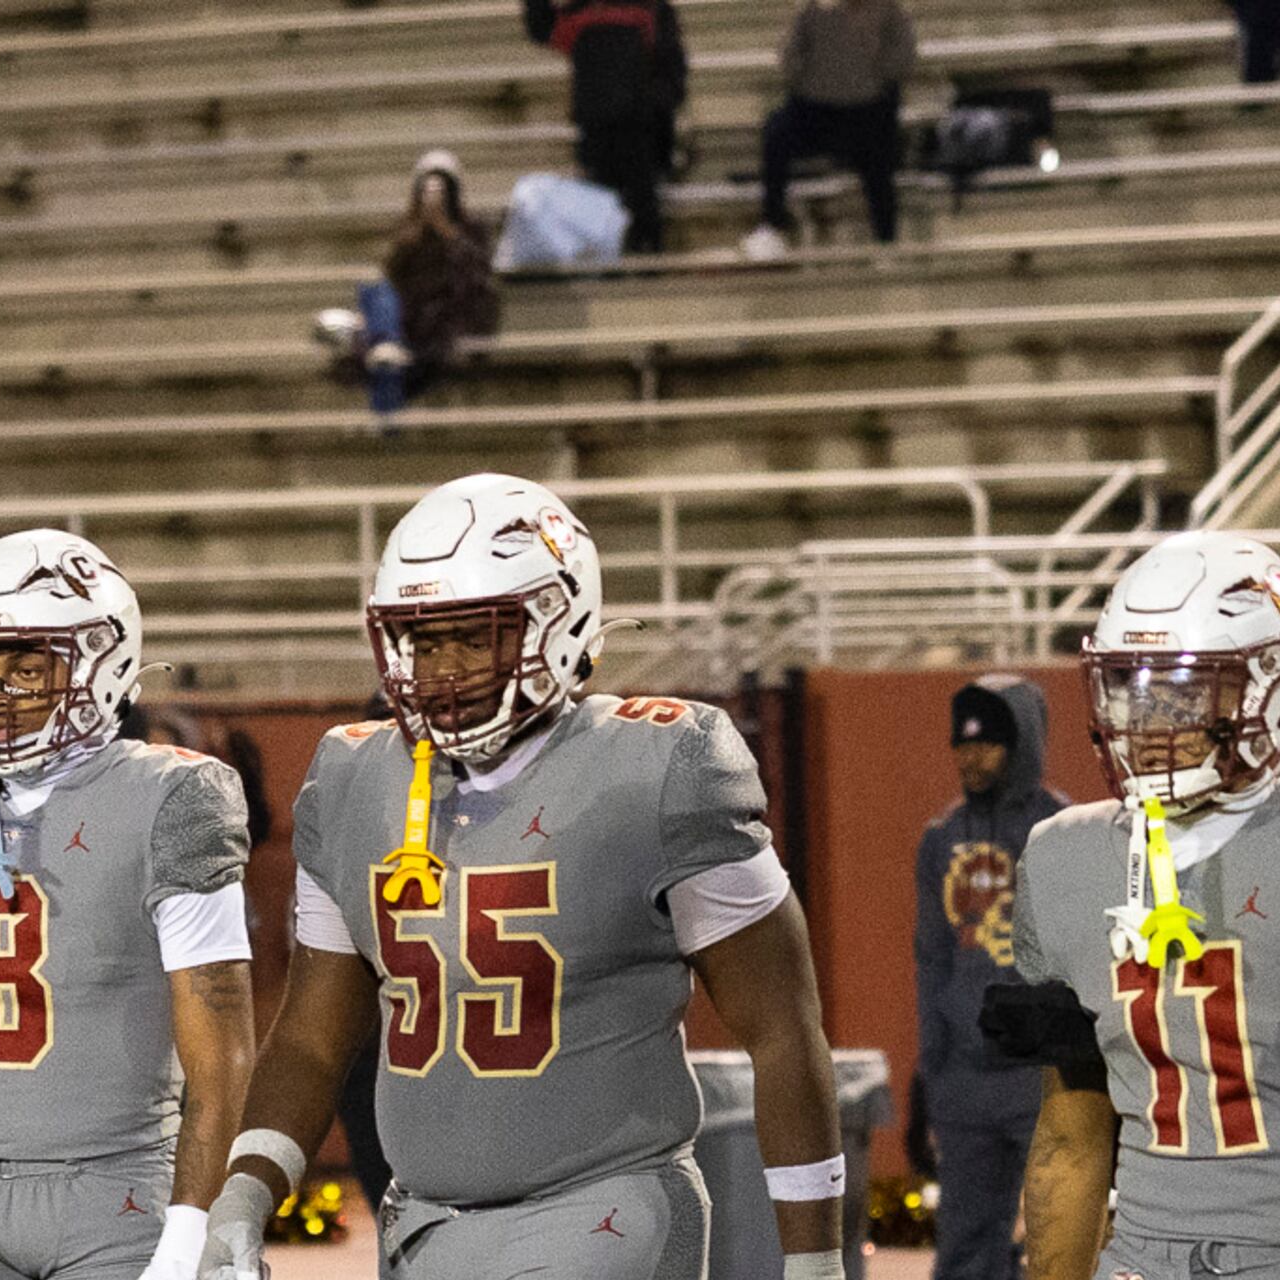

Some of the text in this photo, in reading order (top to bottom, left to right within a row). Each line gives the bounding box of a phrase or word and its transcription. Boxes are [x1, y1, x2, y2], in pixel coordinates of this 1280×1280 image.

[70, 556, 97, 580] C
[369, 861, 564, 1078] 55
[1112, 940, 1269, 1155] 11
